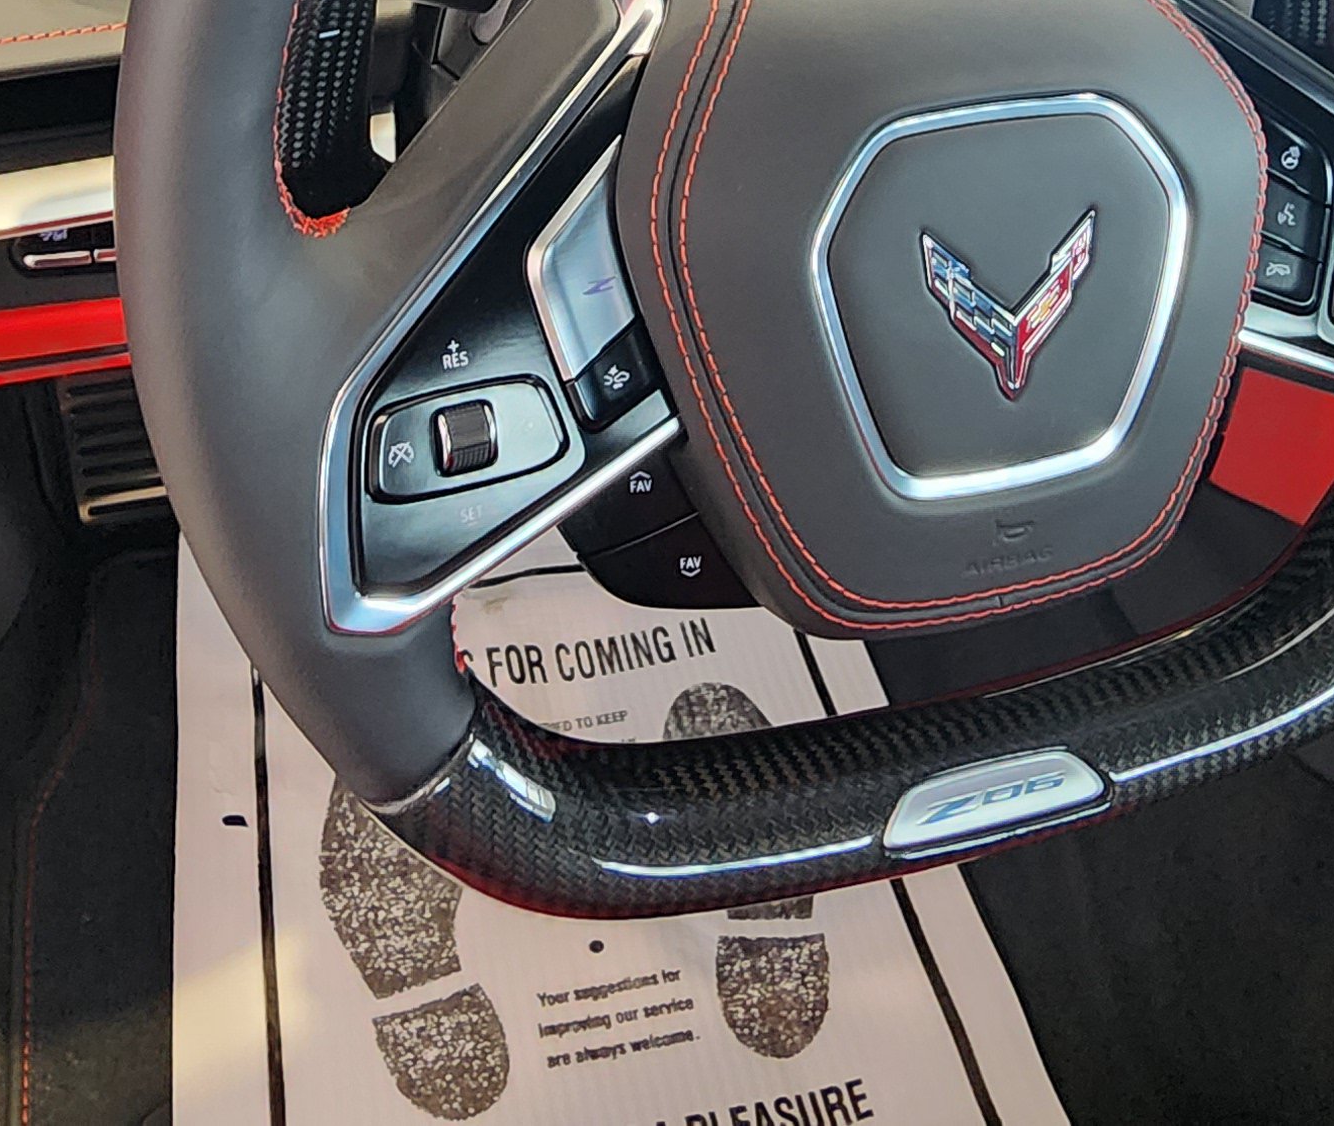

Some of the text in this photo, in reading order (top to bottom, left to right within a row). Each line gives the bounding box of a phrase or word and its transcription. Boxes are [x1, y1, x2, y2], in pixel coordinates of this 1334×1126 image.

[442, 351, 469, 370] RES
[629, 480, 652, 493] FAV
[460, 505, 483, 521] SET
[680, 556, 702, 569] FAV
[963, 546, 1053, 577] AIRBAG
[486, 617, 716, 688] FOR COMING IN
[575, 716, 593, 729] TO
[596, 710, 628, 725] KEEP
[918, 770, 1066, 825] Z06
[537, 969, 681, 1007] Your suggestions for
[616, 1008, 639, 1024] our
[643, 998, 694, 1018] service
[547, 1053, 571, 1068] are
[575, 1043, 626, 1064] always
